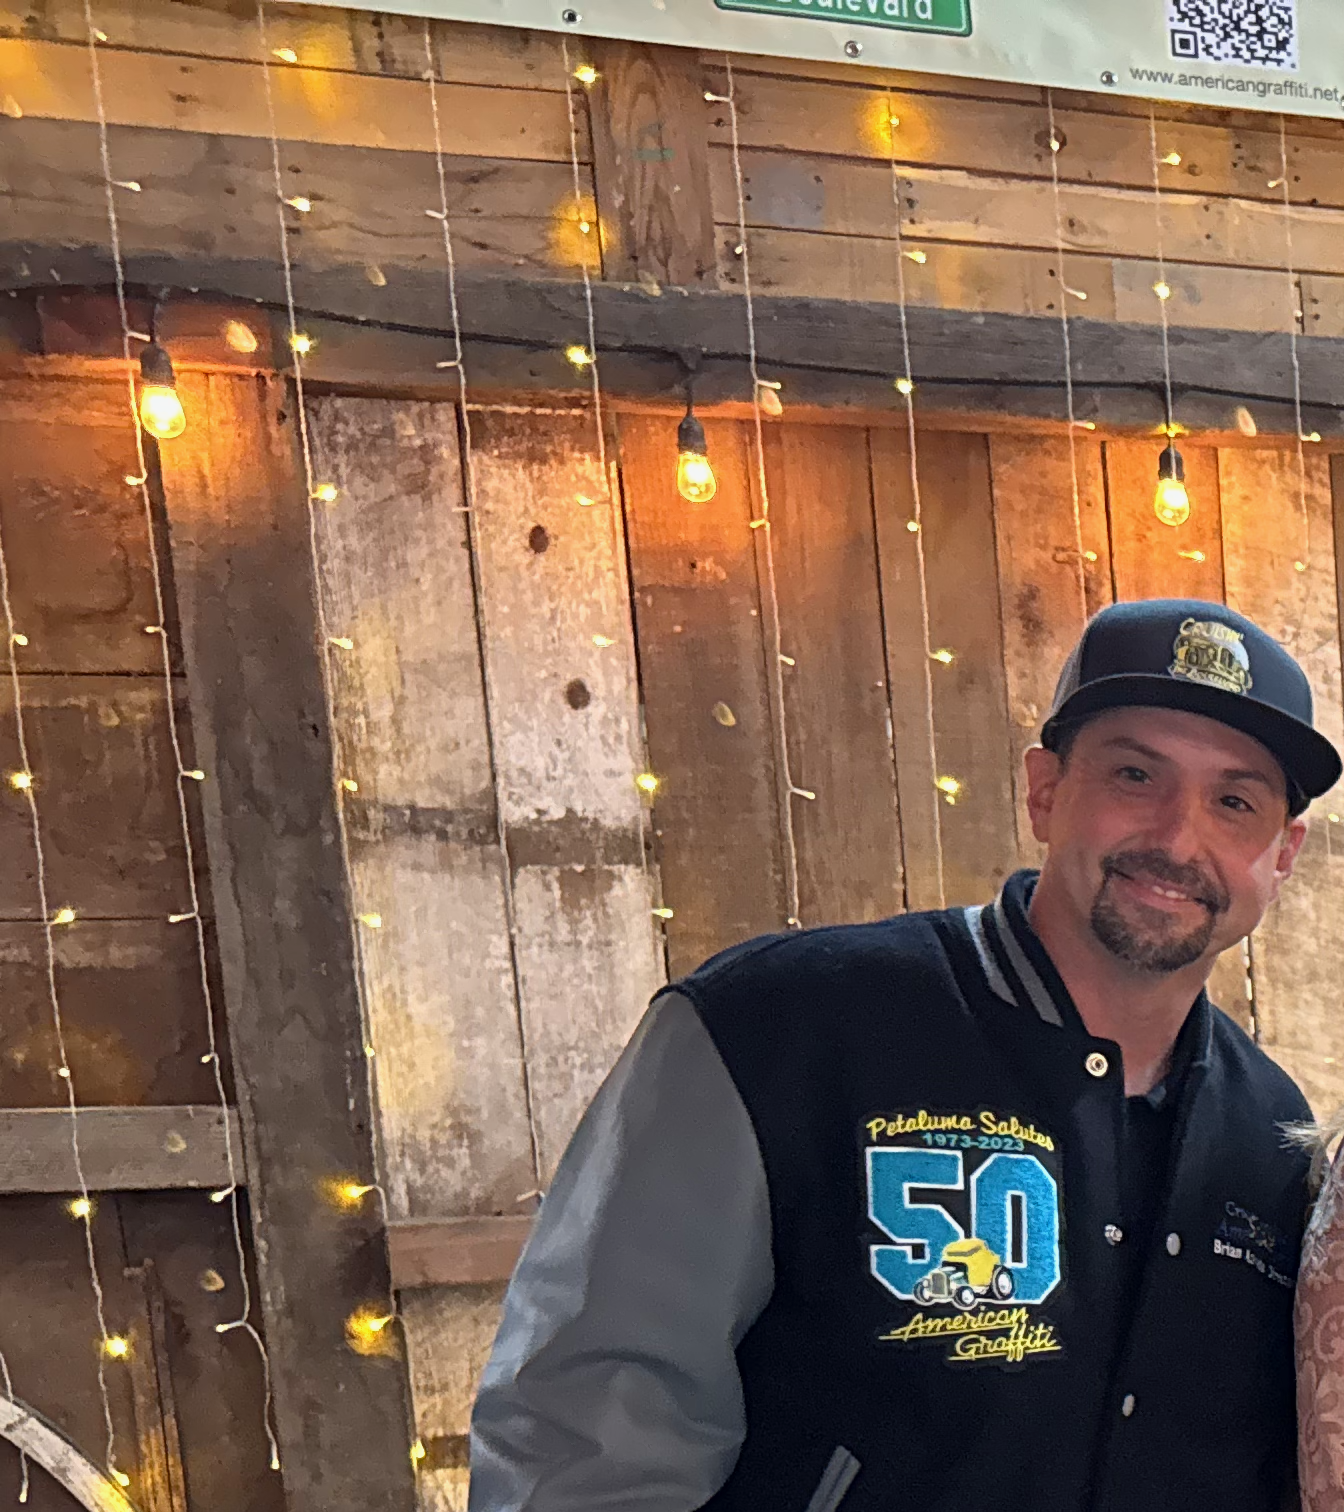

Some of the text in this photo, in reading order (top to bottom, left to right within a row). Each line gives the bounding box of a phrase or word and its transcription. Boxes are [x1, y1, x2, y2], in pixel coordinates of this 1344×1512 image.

[776, 0, 934, 21] evard
[1129, 66, 1340, 102] www.americangraffiti.net
[866, 1110, 1055, 1151] Petaluma Salutes
[921, 1131, 1025, 1152] 1973-2023
[865, 1145, 1061, 1305] 50
[889, 1304, 1029, 1341] American
[954, 1321, 1058, 1362] Graffiti
